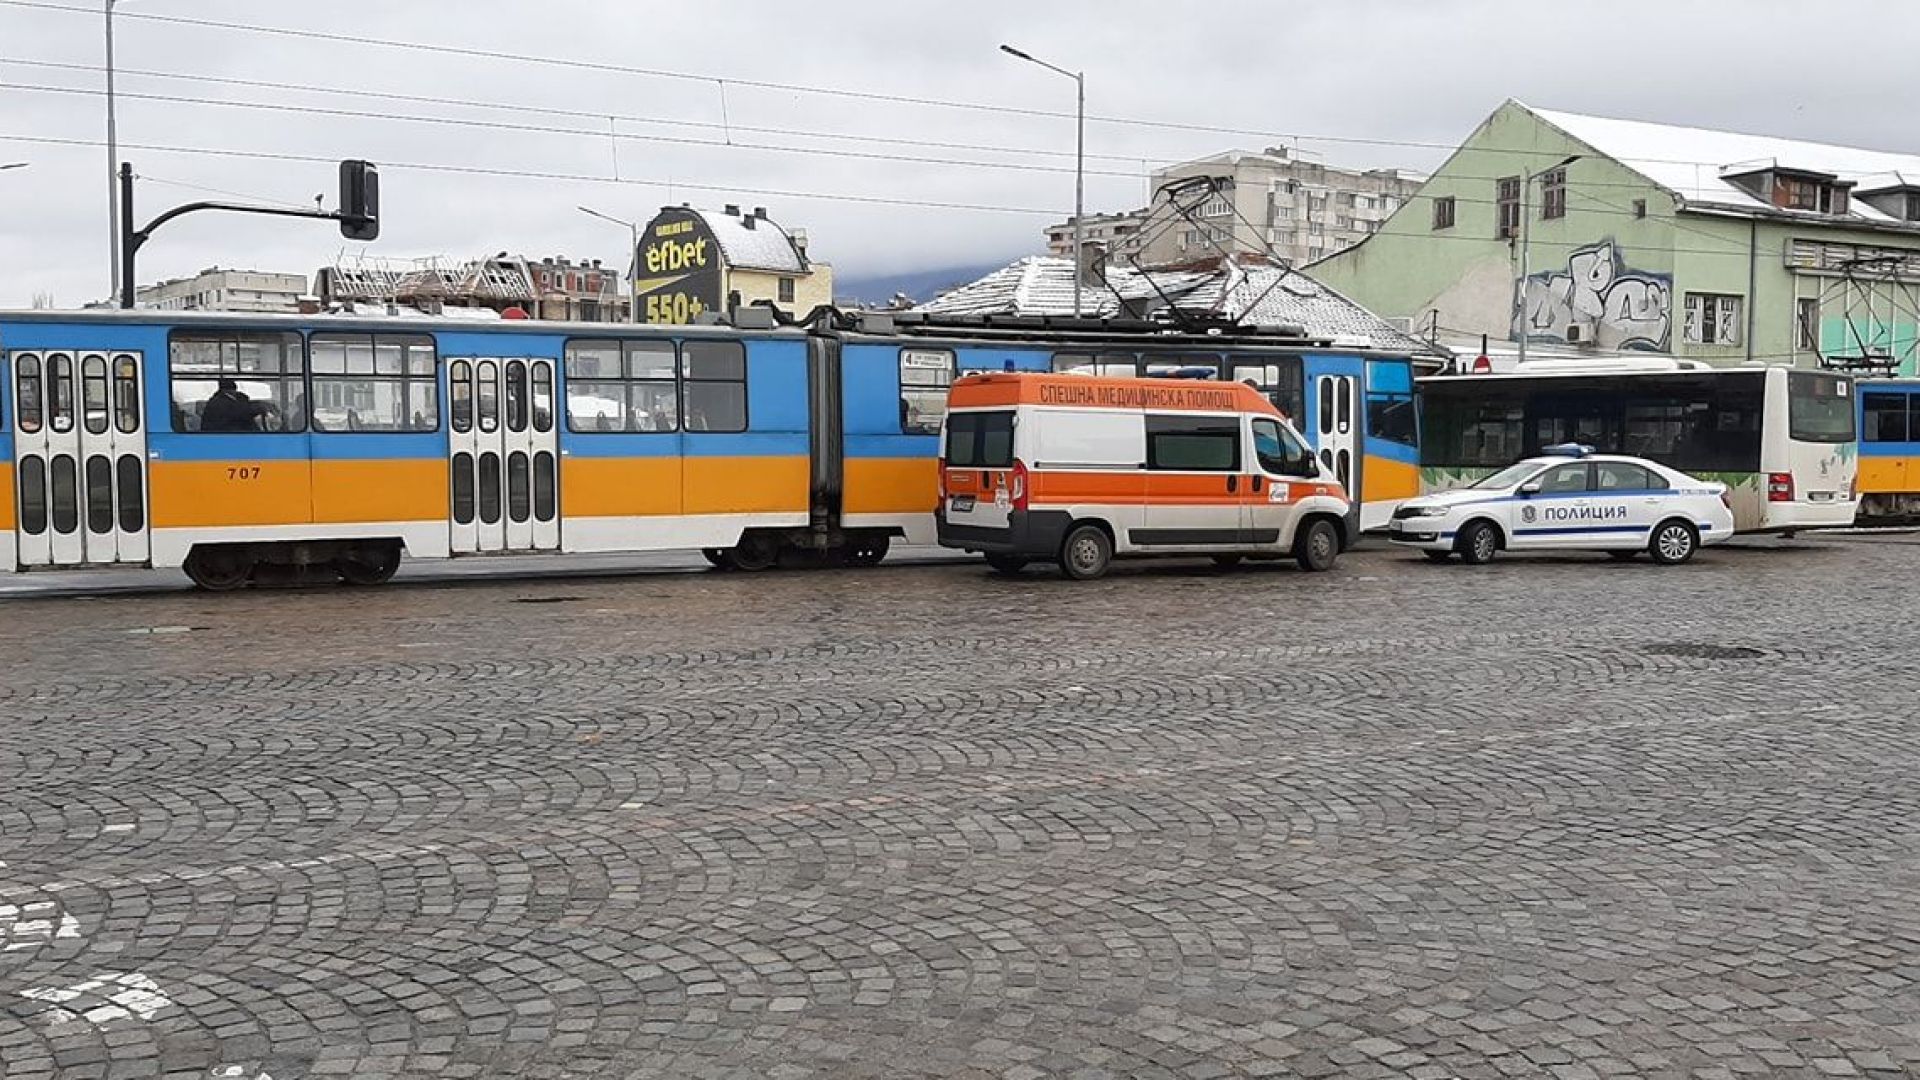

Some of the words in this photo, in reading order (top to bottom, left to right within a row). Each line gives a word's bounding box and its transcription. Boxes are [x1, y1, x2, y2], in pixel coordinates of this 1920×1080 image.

[646, 236, 708, 273] efbet
[647, 292, 702, 325] 550+
[1040, 384, 1095, 404] СПЕШНА
[1097, 387, 1184, 408] МЕДИЦИНСКА
[1187, 389, 1235, 409] ПОМОЩ
[227, 466, 261, 480] 707
[1545, 505, 1628, 521] ПОЛИЦИЯ
